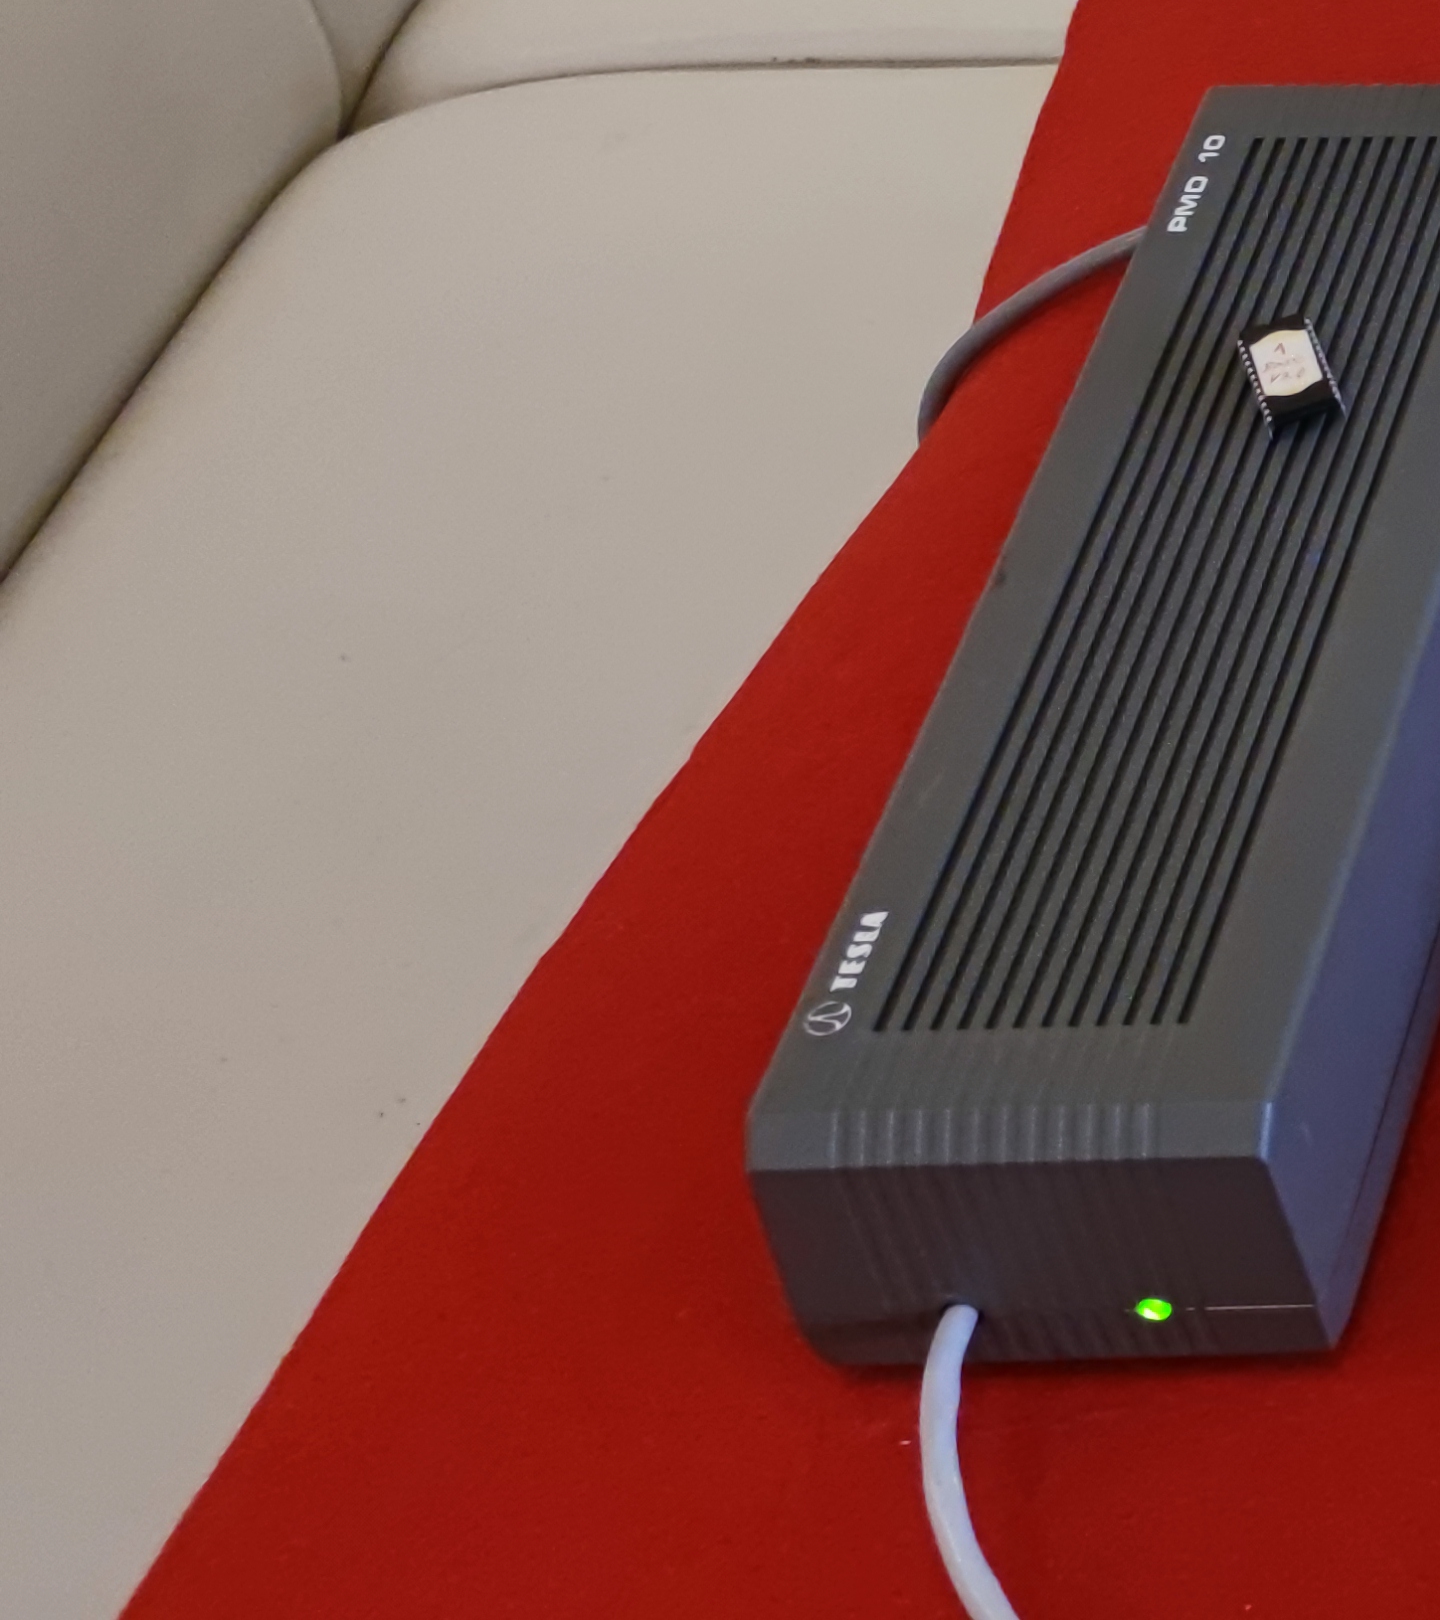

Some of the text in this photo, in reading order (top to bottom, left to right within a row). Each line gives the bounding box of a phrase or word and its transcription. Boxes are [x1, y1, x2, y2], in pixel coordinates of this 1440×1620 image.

[1167, 135, 1226, 232] PMD 10
[830, 911, 889, 992] TESLA
